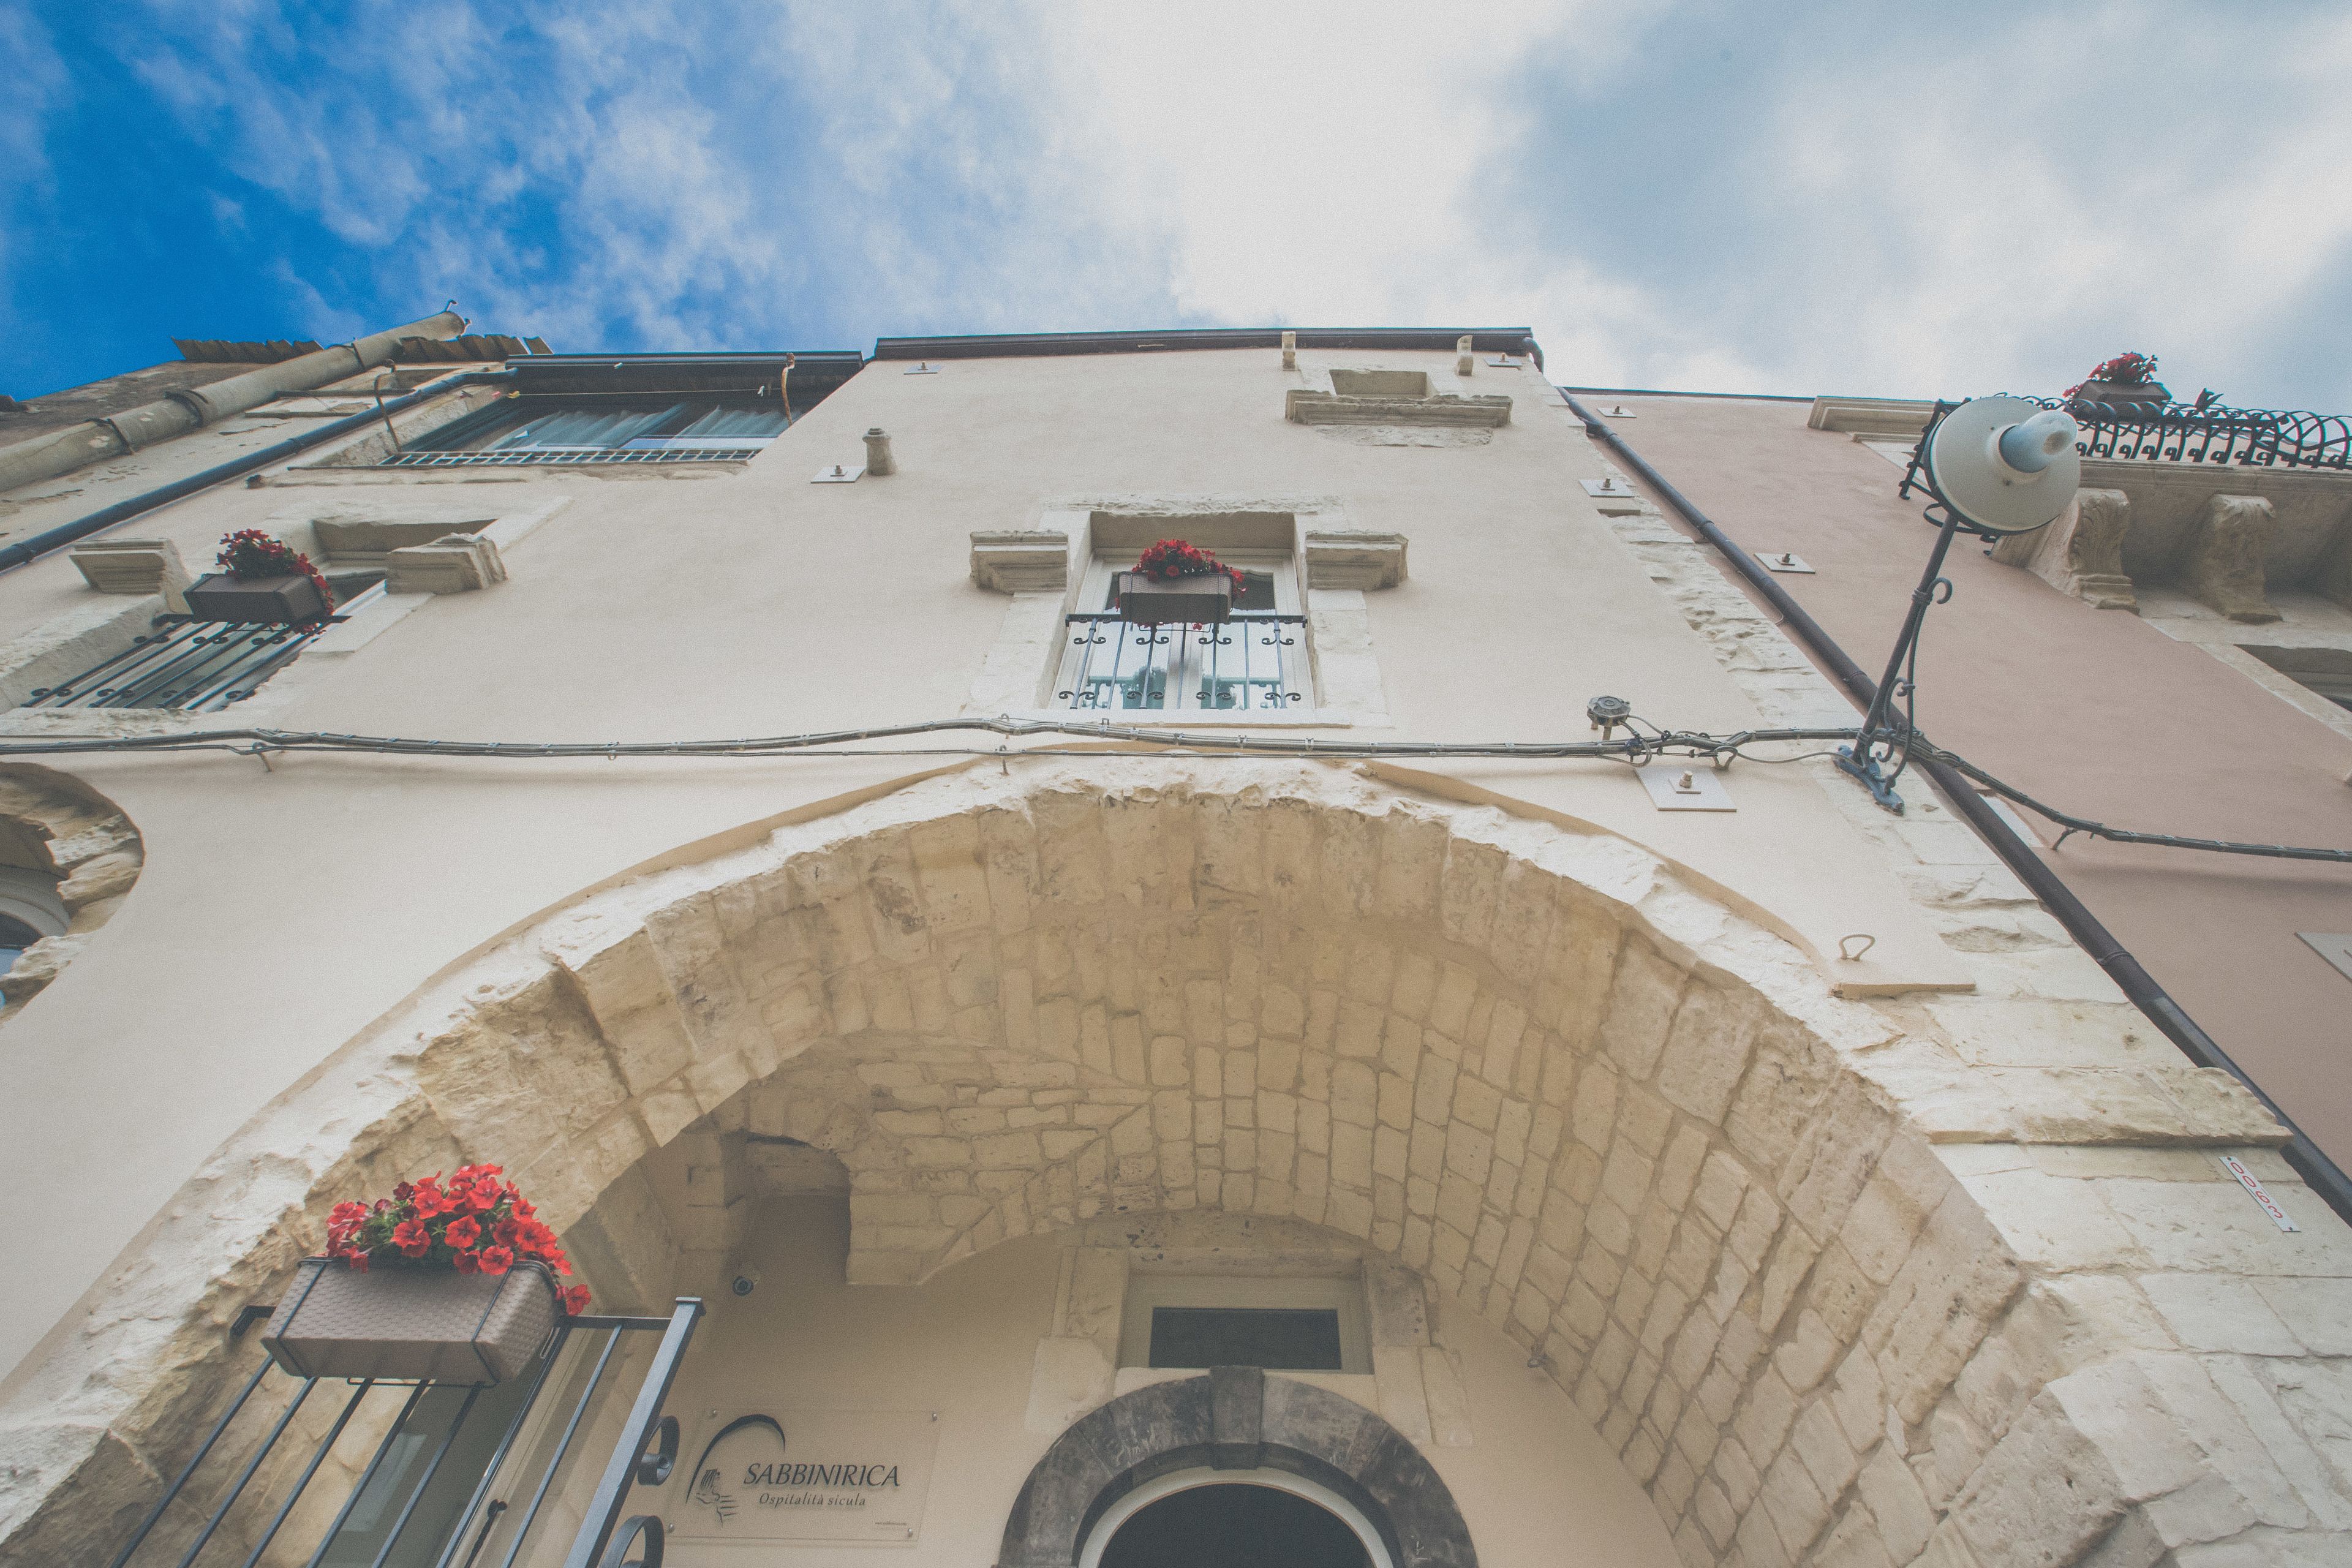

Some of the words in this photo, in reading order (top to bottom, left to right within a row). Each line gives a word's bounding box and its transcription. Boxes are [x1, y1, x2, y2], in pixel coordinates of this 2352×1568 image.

[2230, 1162, 2283, 1218] 0063
[744, 1463, 900, 1487] SABBINIRICA
[759, 1492, 824, 1509] Ospitalità
[827, 1493, 866, 1506] sicula
